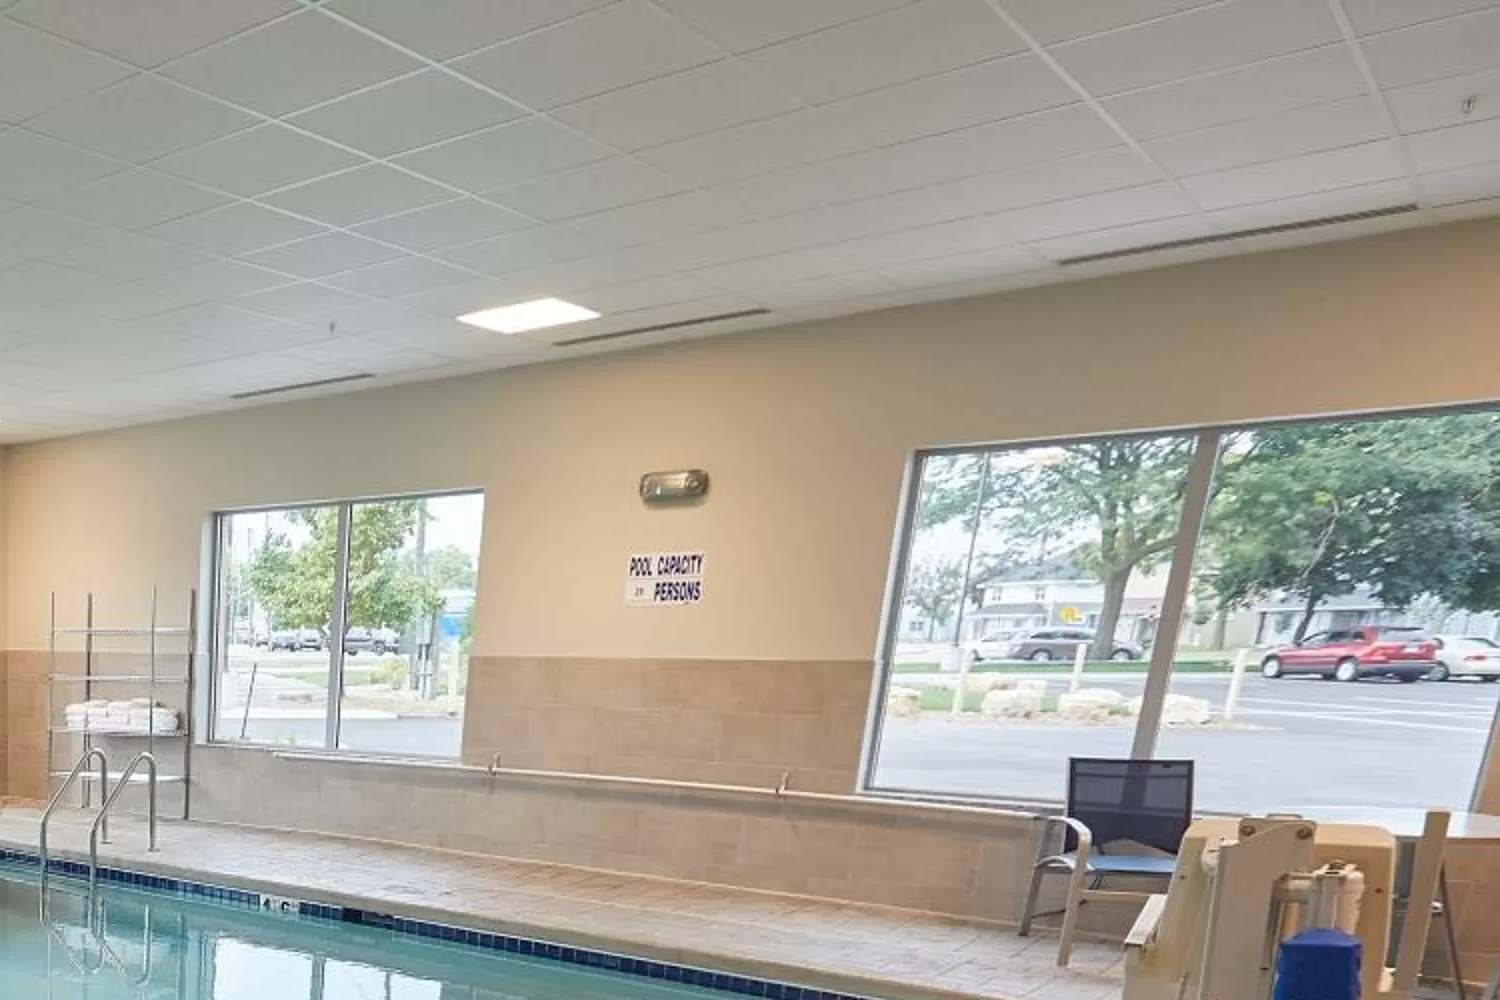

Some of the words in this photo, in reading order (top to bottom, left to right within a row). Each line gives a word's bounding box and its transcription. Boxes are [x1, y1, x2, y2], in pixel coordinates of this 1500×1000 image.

[629, 556, 653, 577] POOL
[657, 553, 704, 576] CAPACITY
[653, 580, 701, 602] PERSONS
